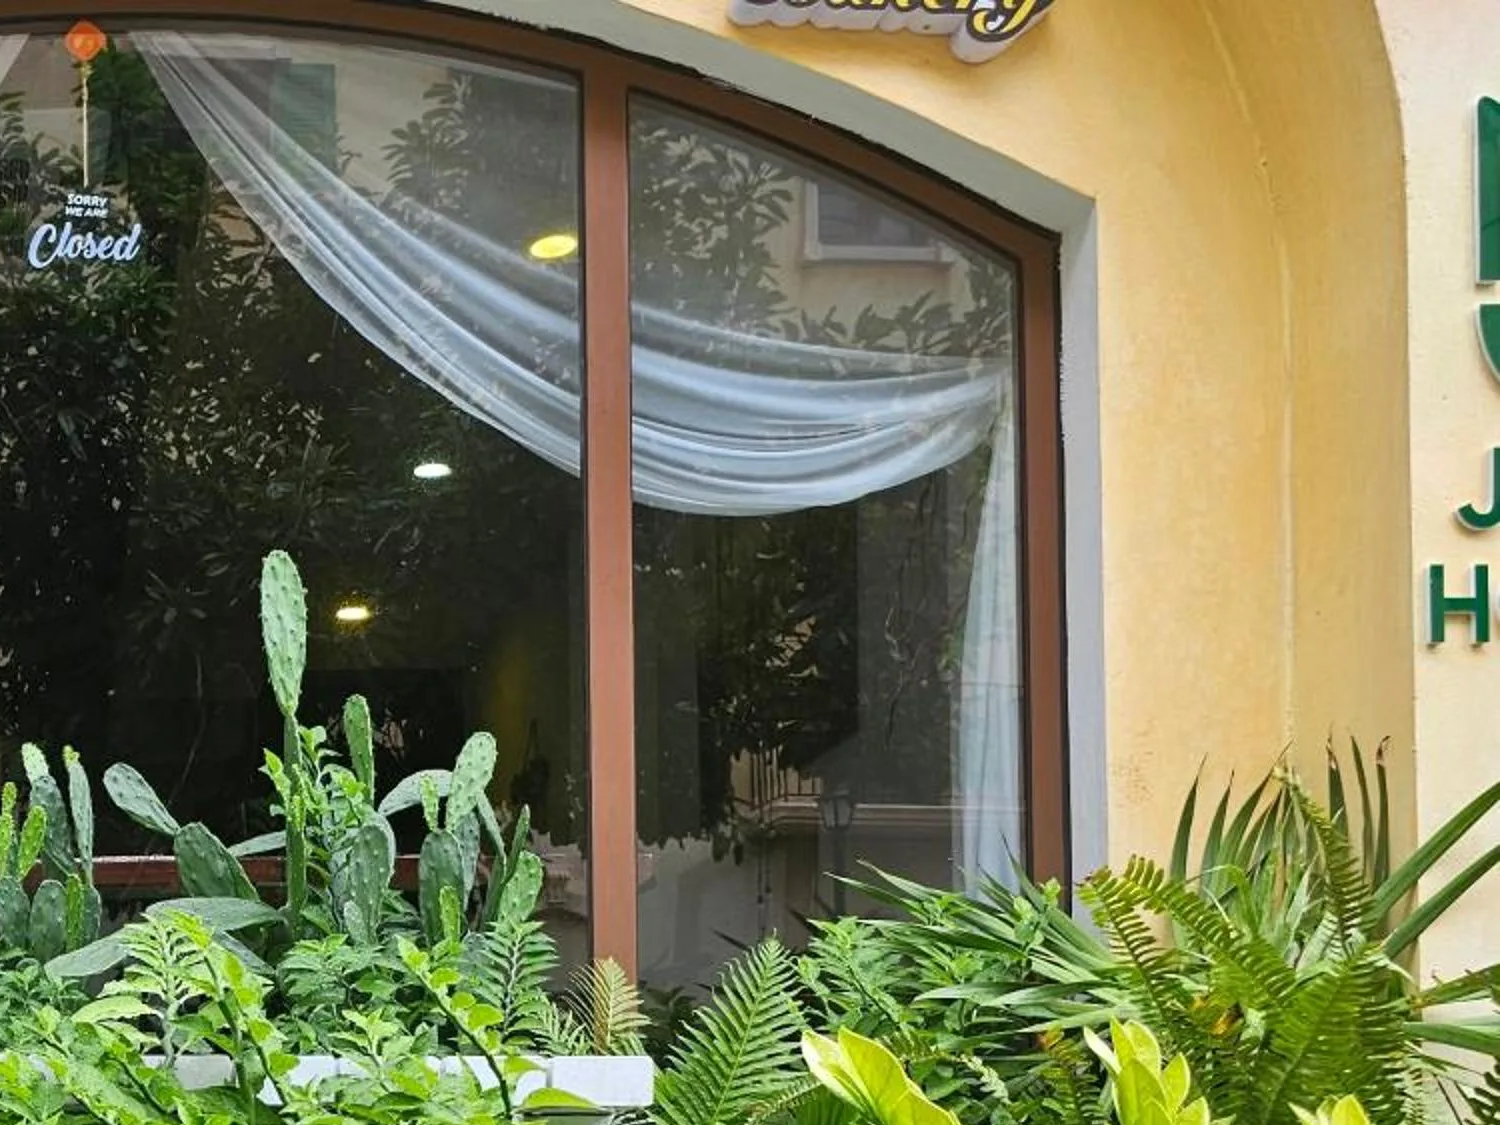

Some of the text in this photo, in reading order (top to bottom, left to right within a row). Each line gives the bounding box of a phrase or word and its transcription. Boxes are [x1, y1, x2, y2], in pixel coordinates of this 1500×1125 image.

[67, 193, 108, 208] SORRY
[65, 206, 109, 219] WE ARE
[27, 221, 142, 269] Closed
